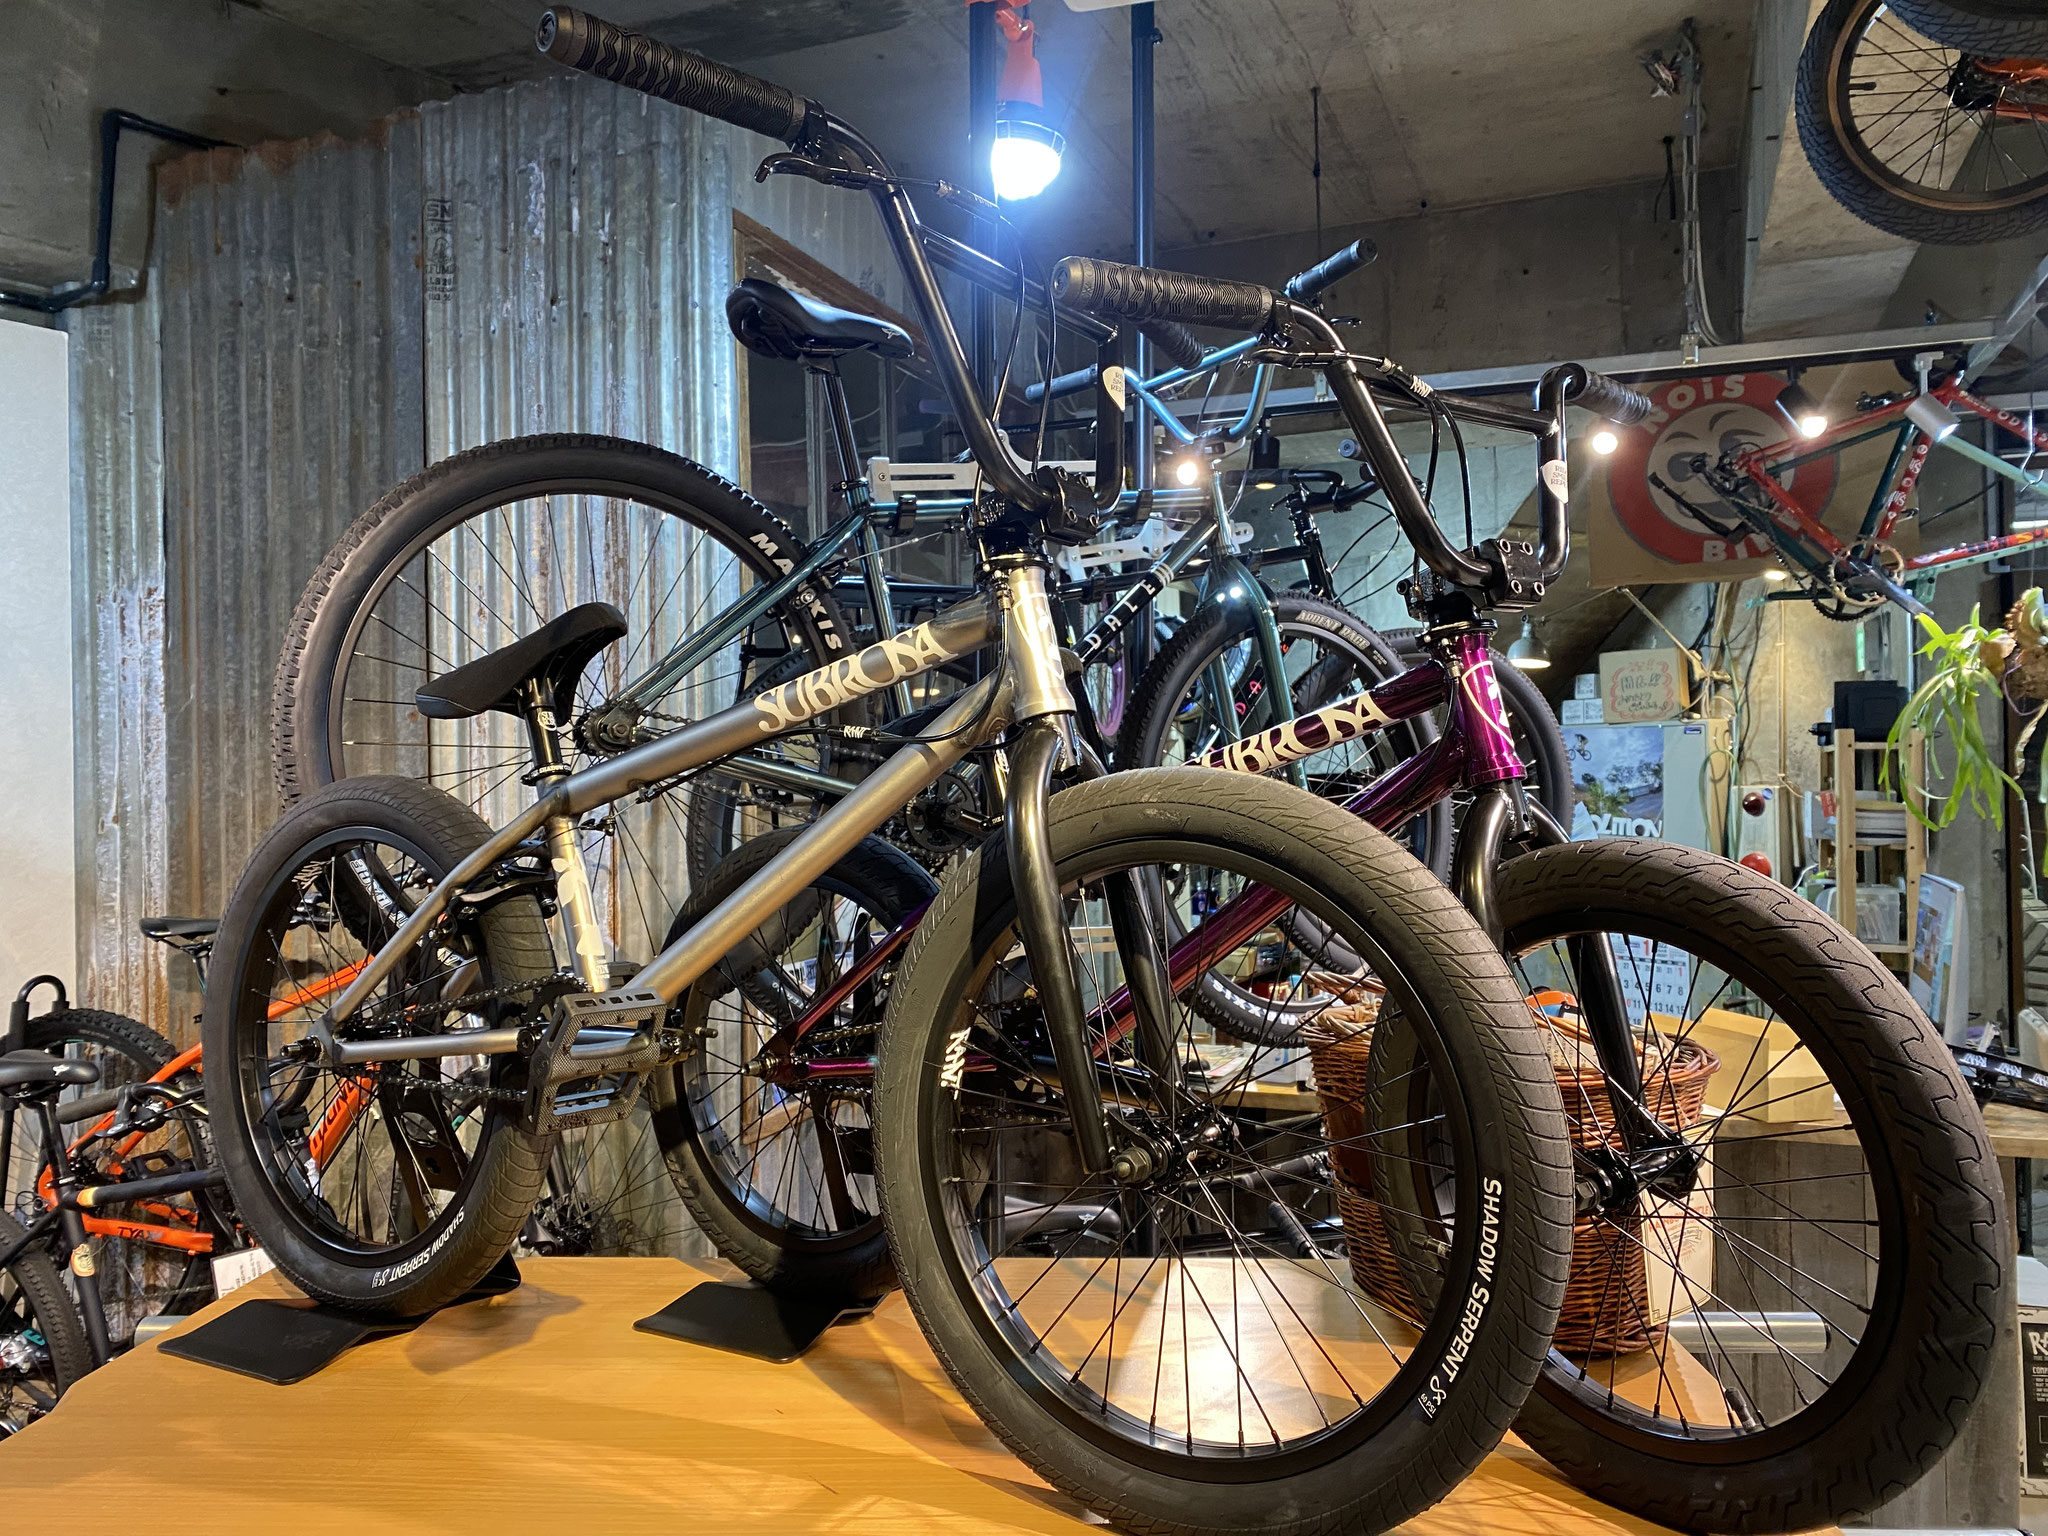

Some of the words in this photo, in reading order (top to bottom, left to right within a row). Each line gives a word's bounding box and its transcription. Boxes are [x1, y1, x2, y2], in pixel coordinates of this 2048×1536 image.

[1295, 610, 1342, 635] ARDENT
[1338, 625, 1371, 649] RACE
[754, 621, 958, 732] SUBROSA
[1196, 691, 1398, 776] UBROSA
[1643, 940, 1650, 956] 1
[1623, 979, 1629, 989] 3
[1634, 982, 1640, 990] 4
[1645, 982, 1650, 992] 5
[1655, 983, 1661, 993] 6
[1667, 985, 1672, 994] 7
[1678, 986, 1684, 996] 8
[1678, 967, 1682, 976] 1
[1633, 1000, 1641, 1009] 11
[1654, 1003, 1663, 1012] 13
[1665, 1004, 1674, 1014] 14
[1676, 1006, 1684, 1015] 15
[431, 1206, 465, 1257] SHADOW
[1483, 1177, 1502, 1283] SHADOW
[389, 1247, 431, 1282] SERPENT
[1441, 1281, 1490, 1384] SERPENT
[1420, 1393, 1428, 1403] 60
[1425, 1400, 1437, 1415] PSI
